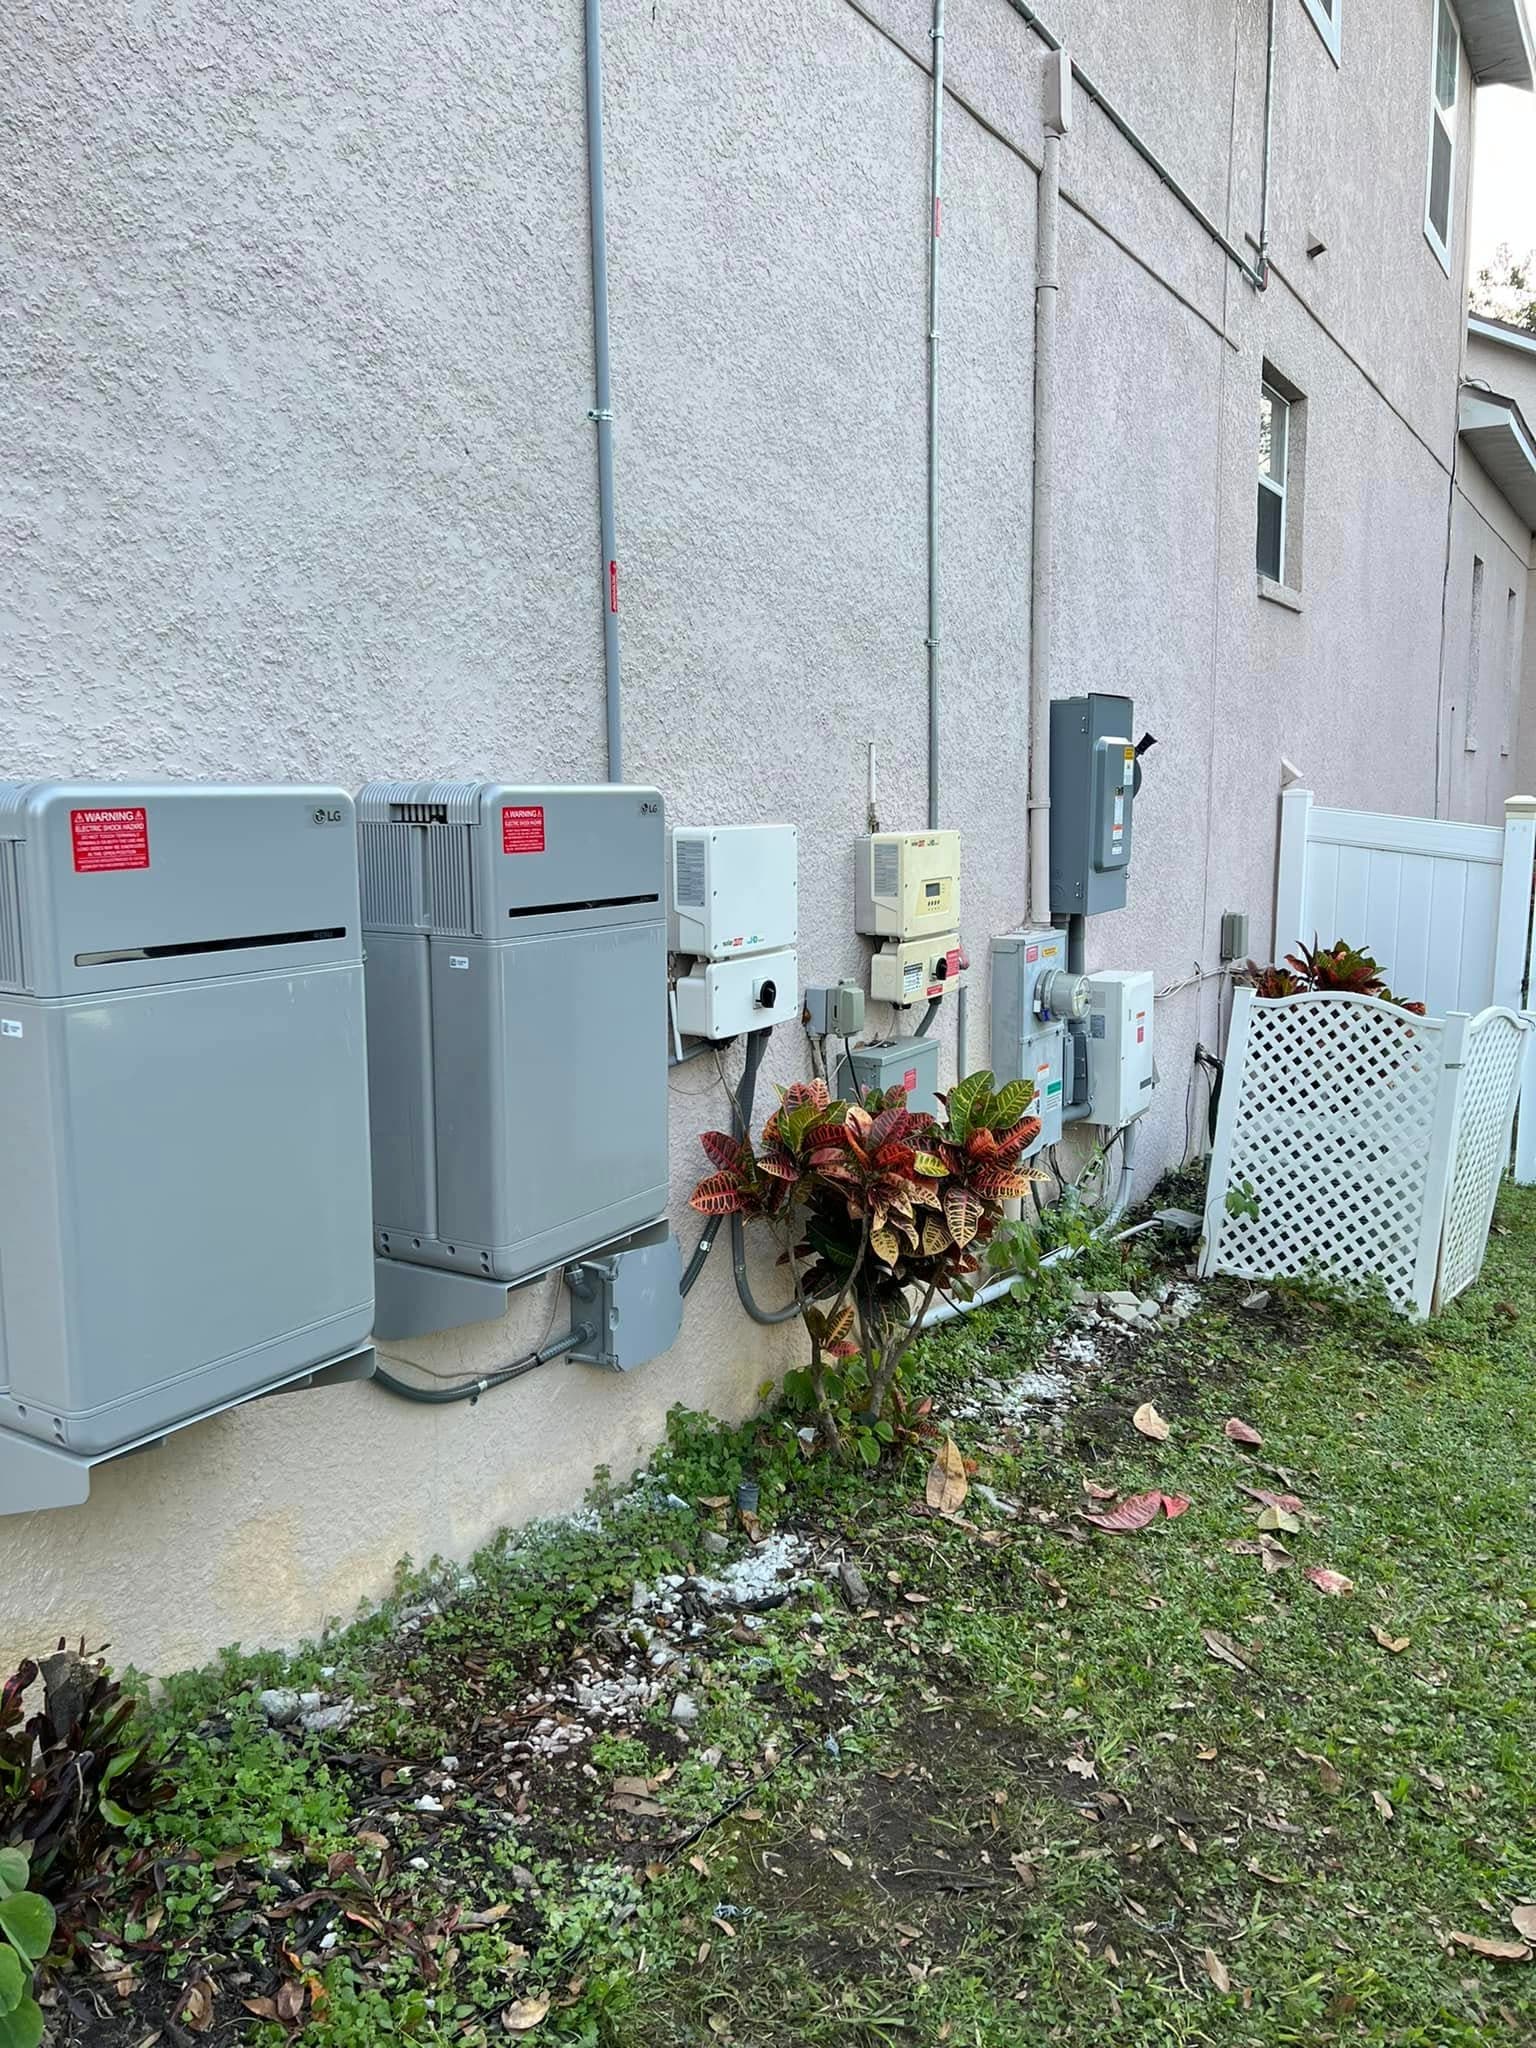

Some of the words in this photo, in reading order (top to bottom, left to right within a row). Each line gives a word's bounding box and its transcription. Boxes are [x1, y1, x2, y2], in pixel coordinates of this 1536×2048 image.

[649, 804, 658, 813] LG
[84, 811, 134, 822] WARNING
[327, 811, 341, 821] LG
[510, 810, 536, 818] WARNING
